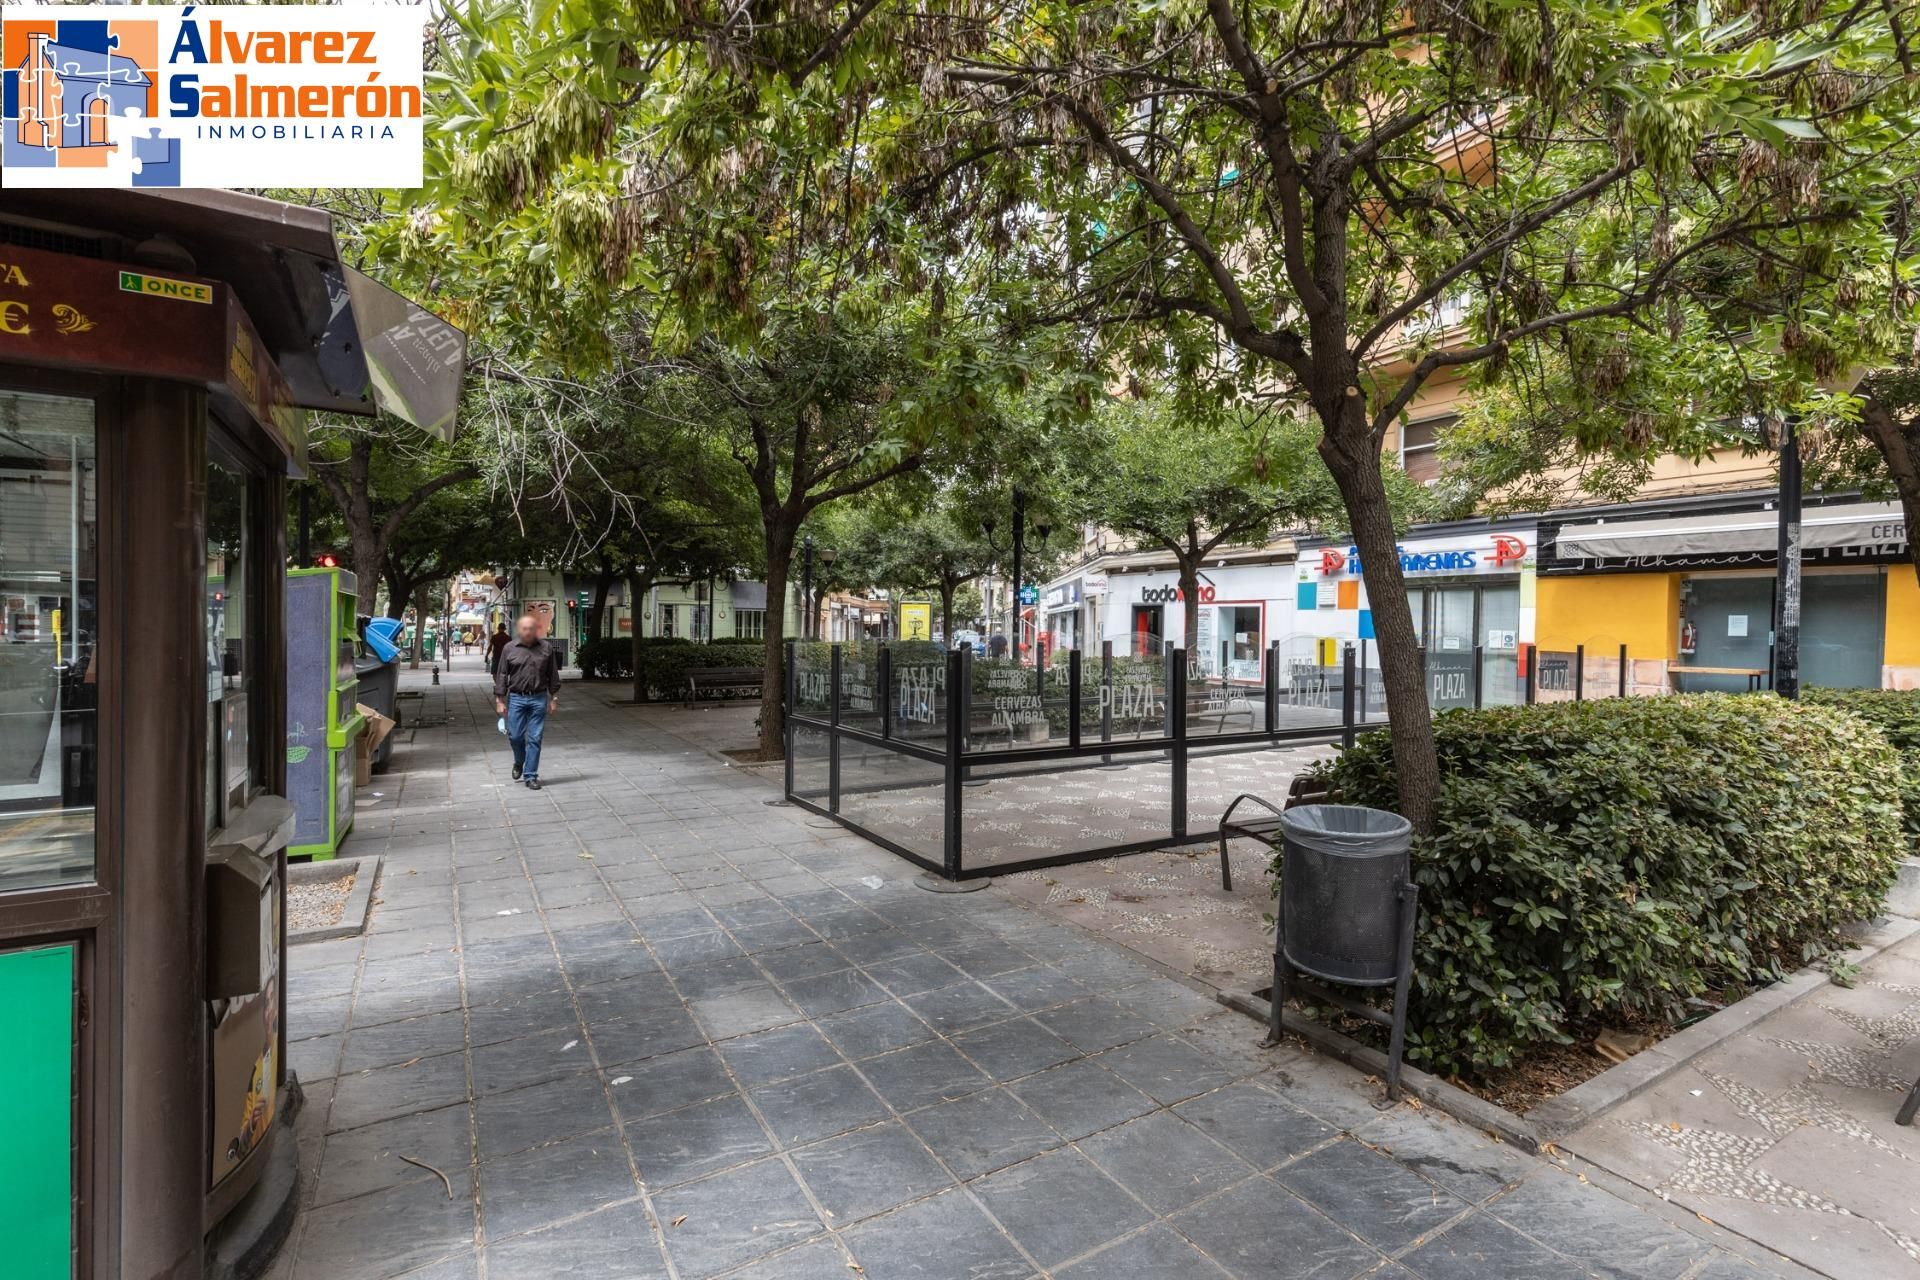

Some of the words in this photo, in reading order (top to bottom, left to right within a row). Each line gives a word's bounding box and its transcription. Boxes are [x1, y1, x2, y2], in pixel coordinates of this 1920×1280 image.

[147, 281, 206, 299] ONCE
[1433, 673, 1466, 701] PLAZA
[1543, 669, 1569, 691] PLAZA
[994, 695, 1042, 710] CERVEZAS
[1099, 683, 1155, 719] PLAZA
[1210, 687, 1246, 701] CERVEZAS
[1288, 679, 1330, 708] PLAZA
[900, 686, 936, 725] PLAZA
[992, 711, 1047, 727] ALHAMBRA
